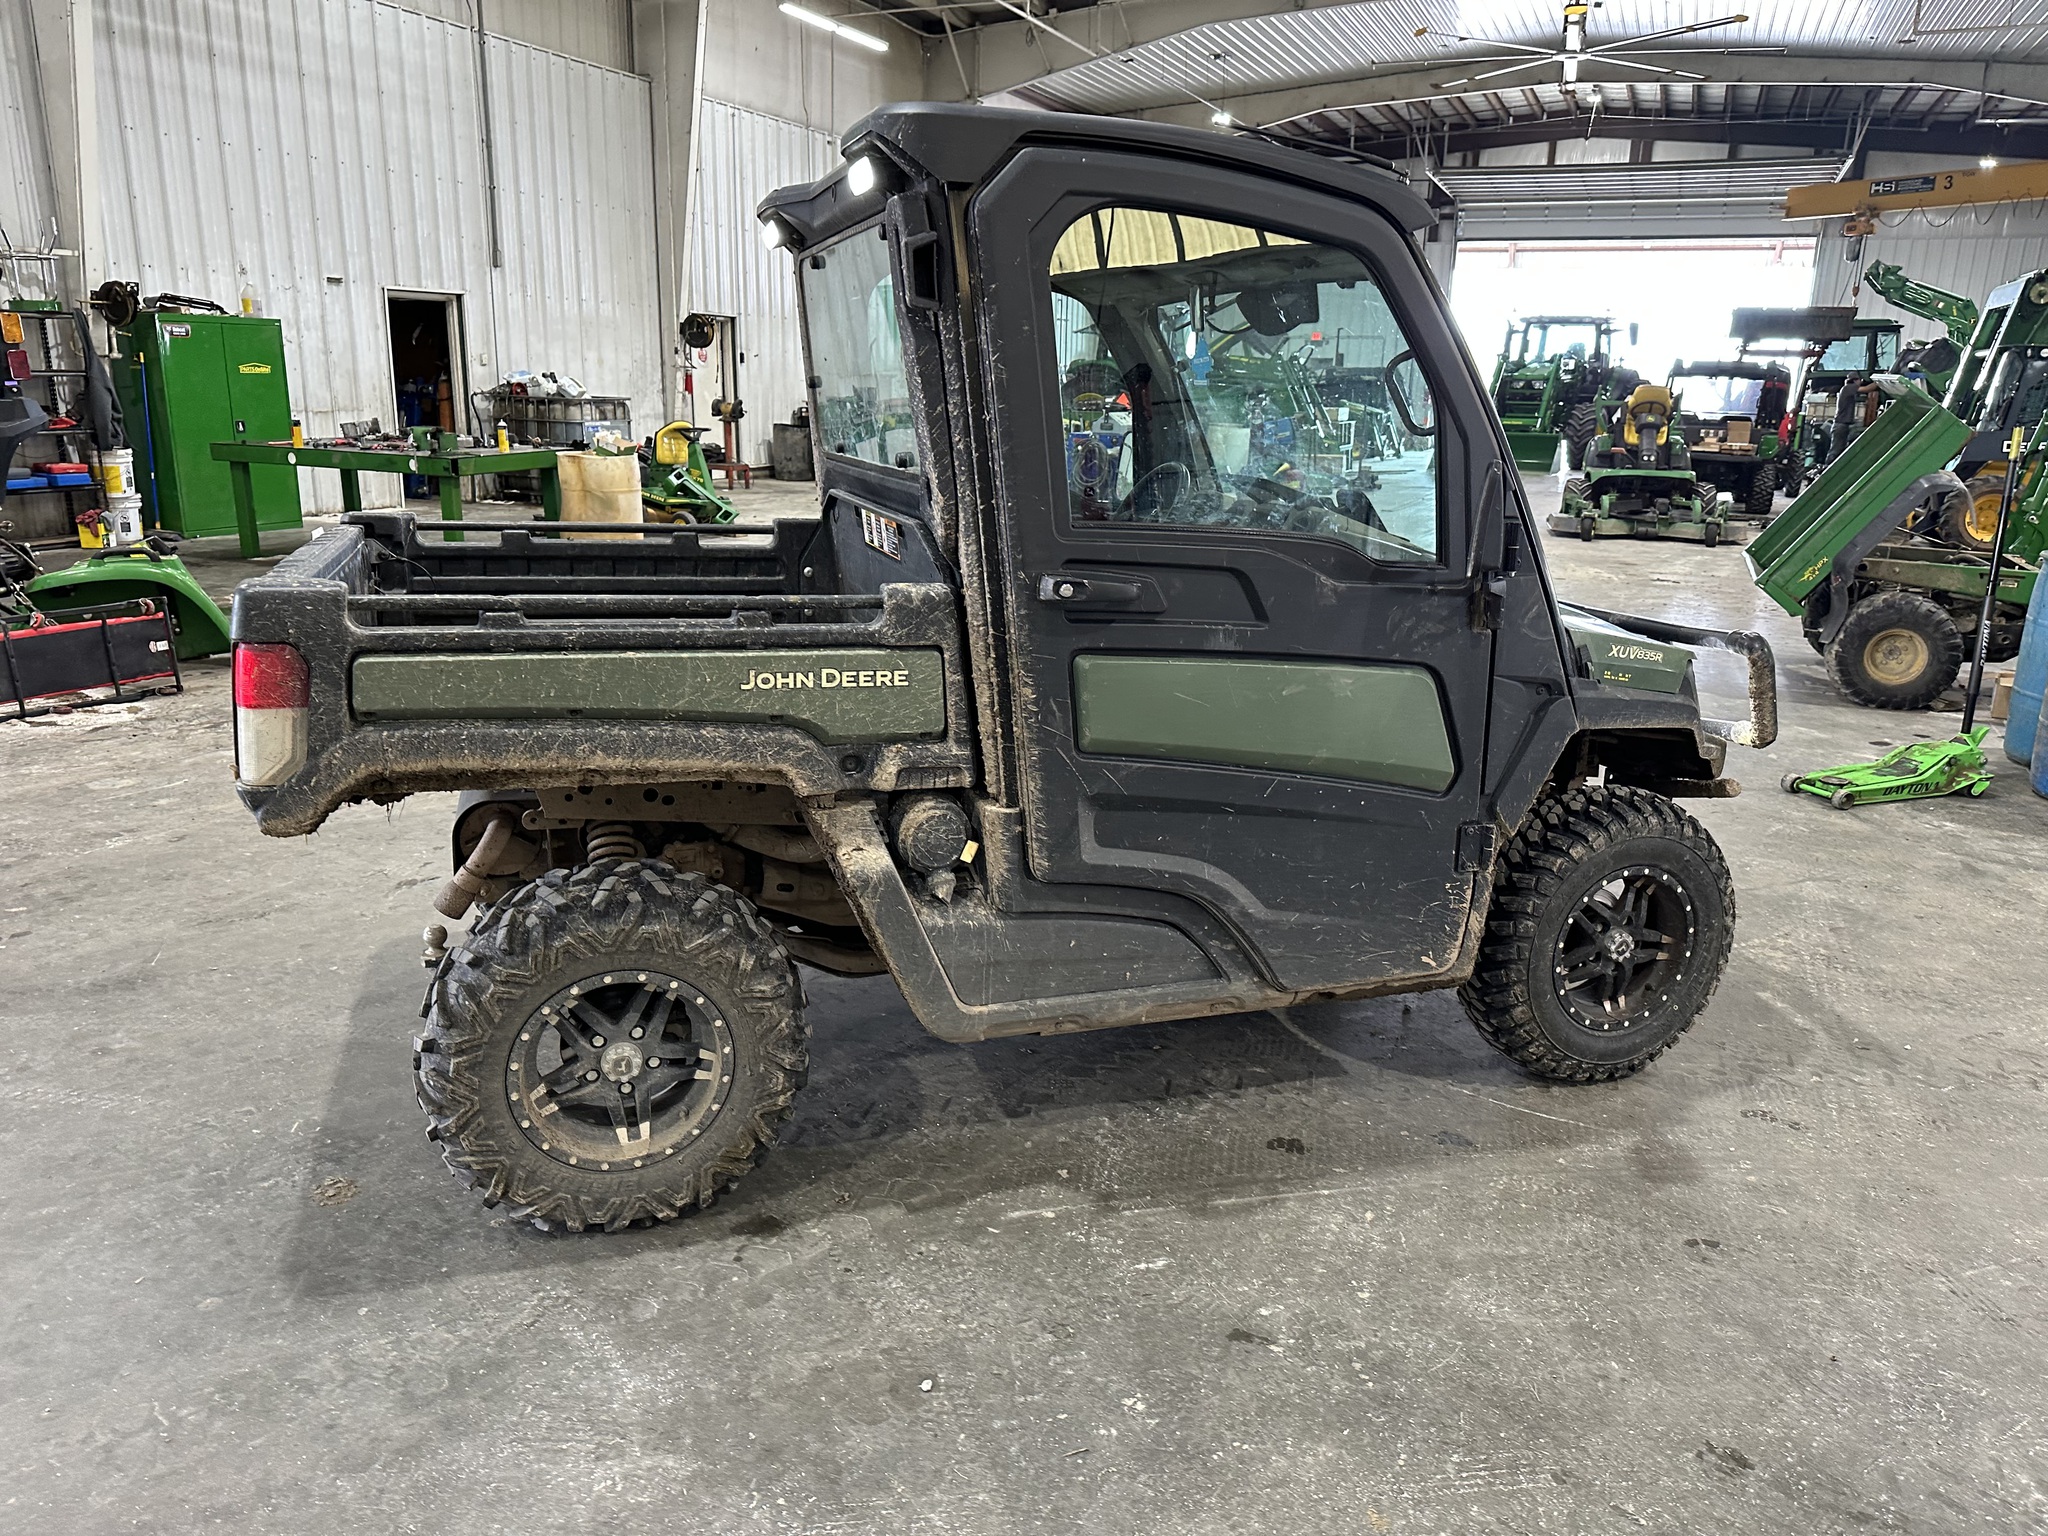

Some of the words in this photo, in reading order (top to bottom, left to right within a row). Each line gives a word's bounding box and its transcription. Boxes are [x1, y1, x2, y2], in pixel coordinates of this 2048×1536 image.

[1943, 175, 1954, 190] 3
[1608, 644, 1663, 663] XUV835R
[740, 669, 814, 690] JOHN
[820, 668, 909, 688] DEERE
